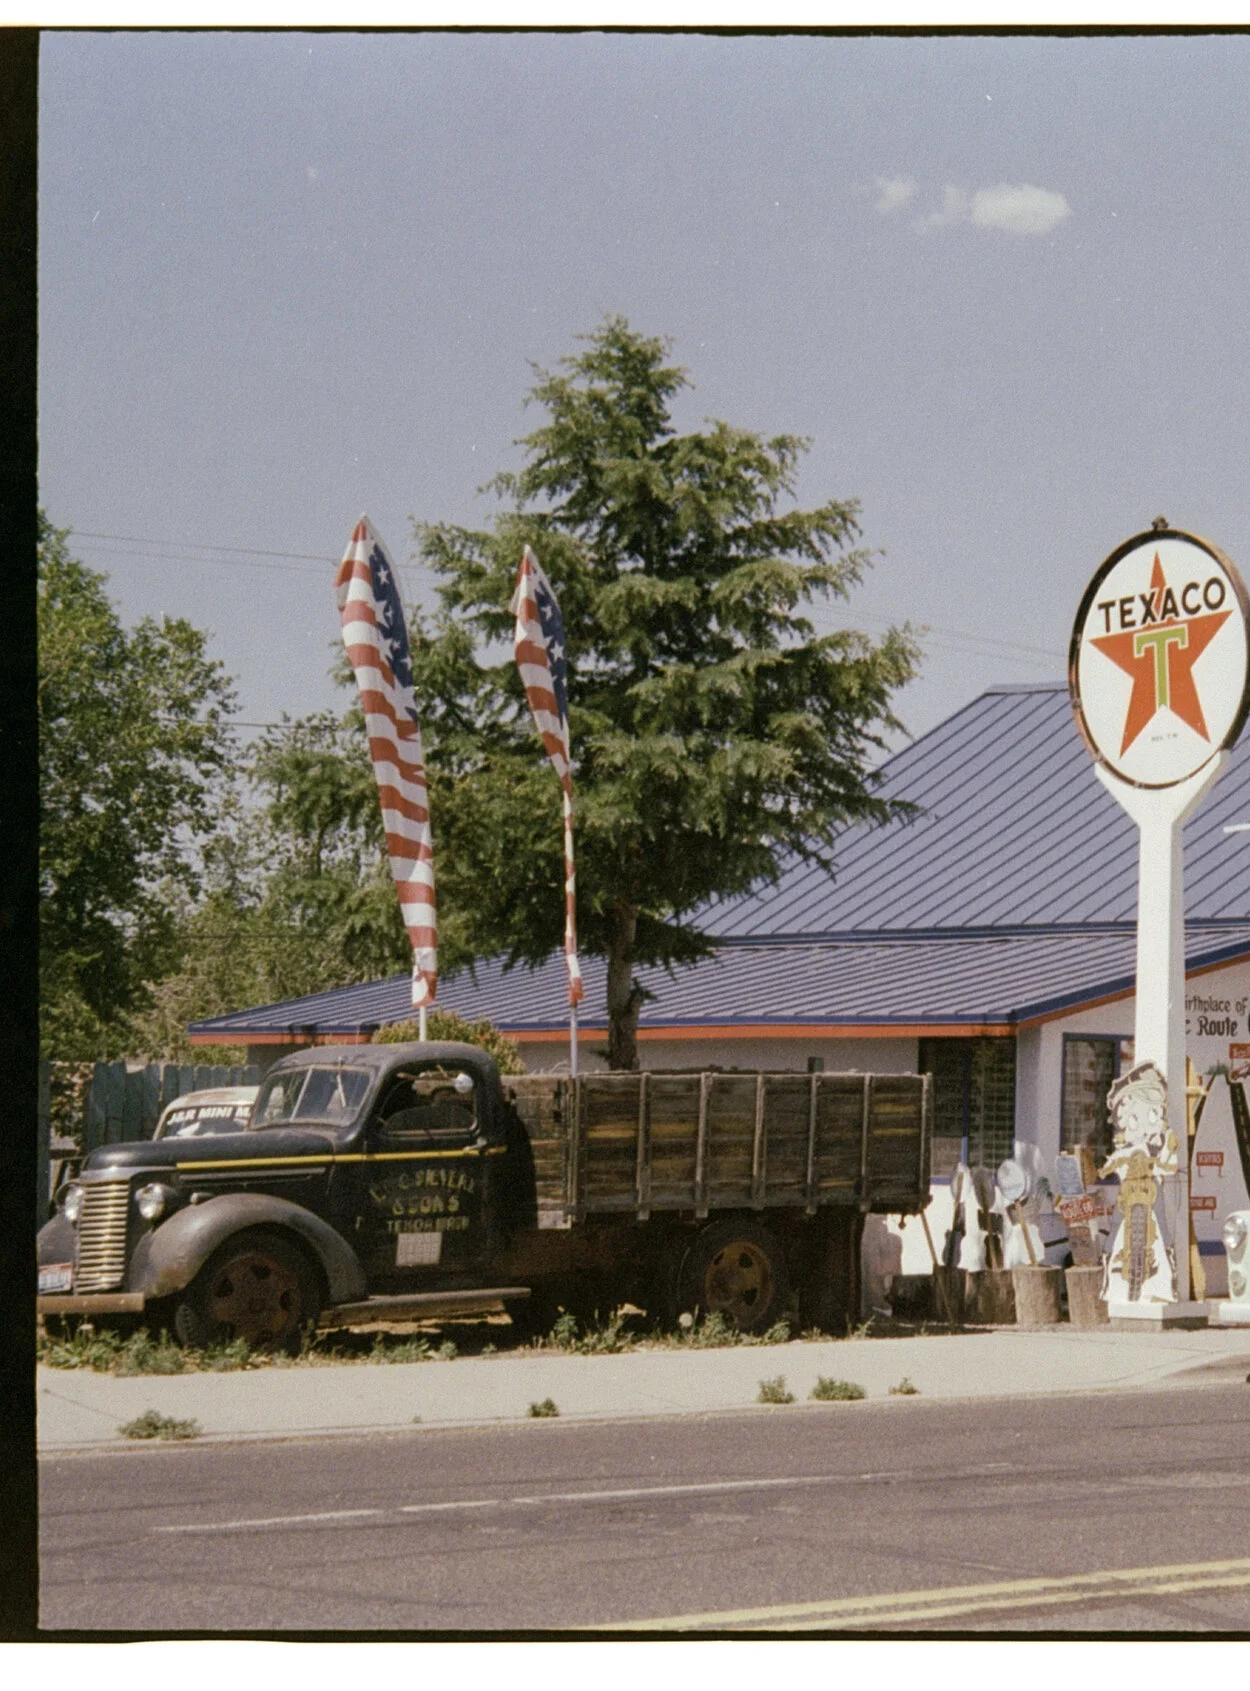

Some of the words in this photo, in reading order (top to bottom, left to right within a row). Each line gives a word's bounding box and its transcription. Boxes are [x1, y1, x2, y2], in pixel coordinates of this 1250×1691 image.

[1097, 577, 1226, 633] TEXACO
[1135, 624, 1188, 710] T
[1235, 997, 1248, 1016] of
[1196, 1015, 1238, 1037] Route
[198, 1107, 234, 1119] MINI
